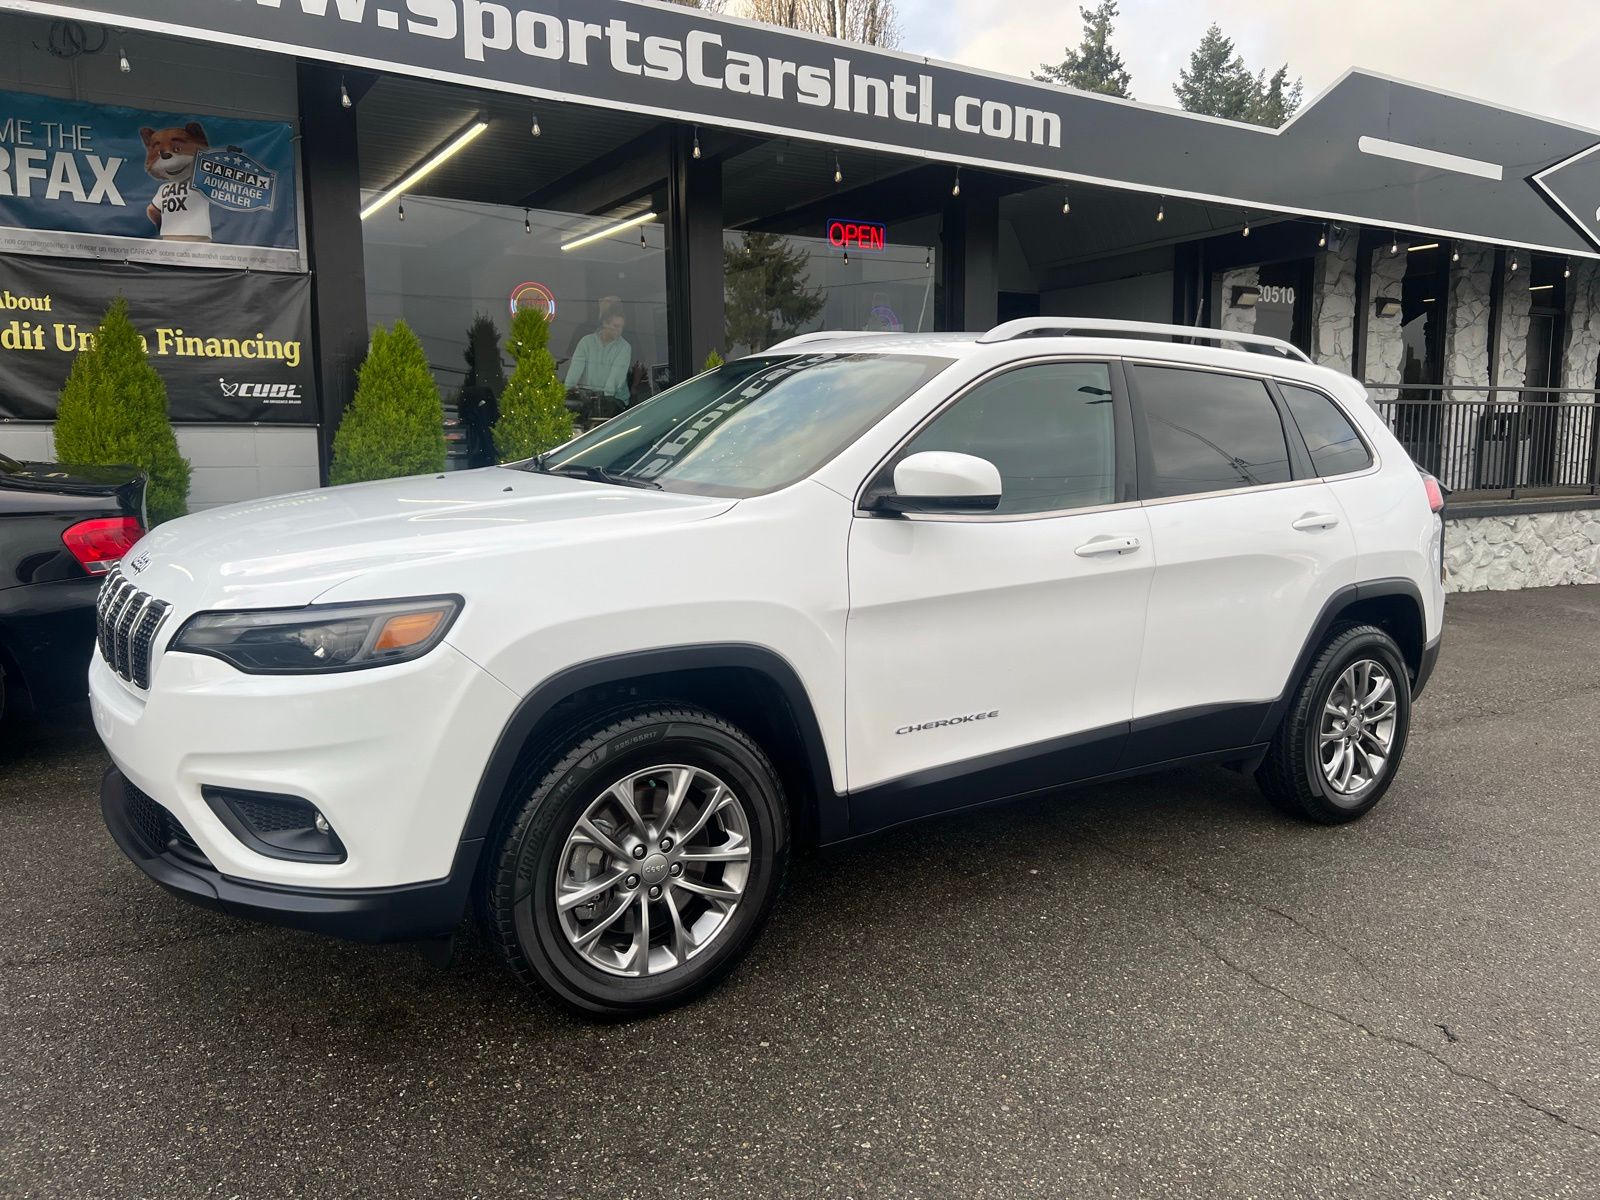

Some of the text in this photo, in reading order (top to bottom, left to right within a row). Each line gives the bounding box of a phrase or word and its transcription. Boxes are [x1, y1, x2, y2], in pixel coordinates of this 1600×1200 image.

[256, 0, 1061, 148] .SportsCarsIntl.com
[40, 123, 93, 152] THE
[202, 160, 269, 190] CARFAX
[203, 175, 263, 200] ADVANTAGE
[161, 181, 188, 199] CAR
[210, 189, 251, 208] DEALER
[161, 196, 188, 214] FOX
[829, 222, 884, 250] OPEN
[156, 328, 301, 367] Financing
[238, 383, 302, 397] CUDL
[895, 710, 999, 735] CHEROKEE
